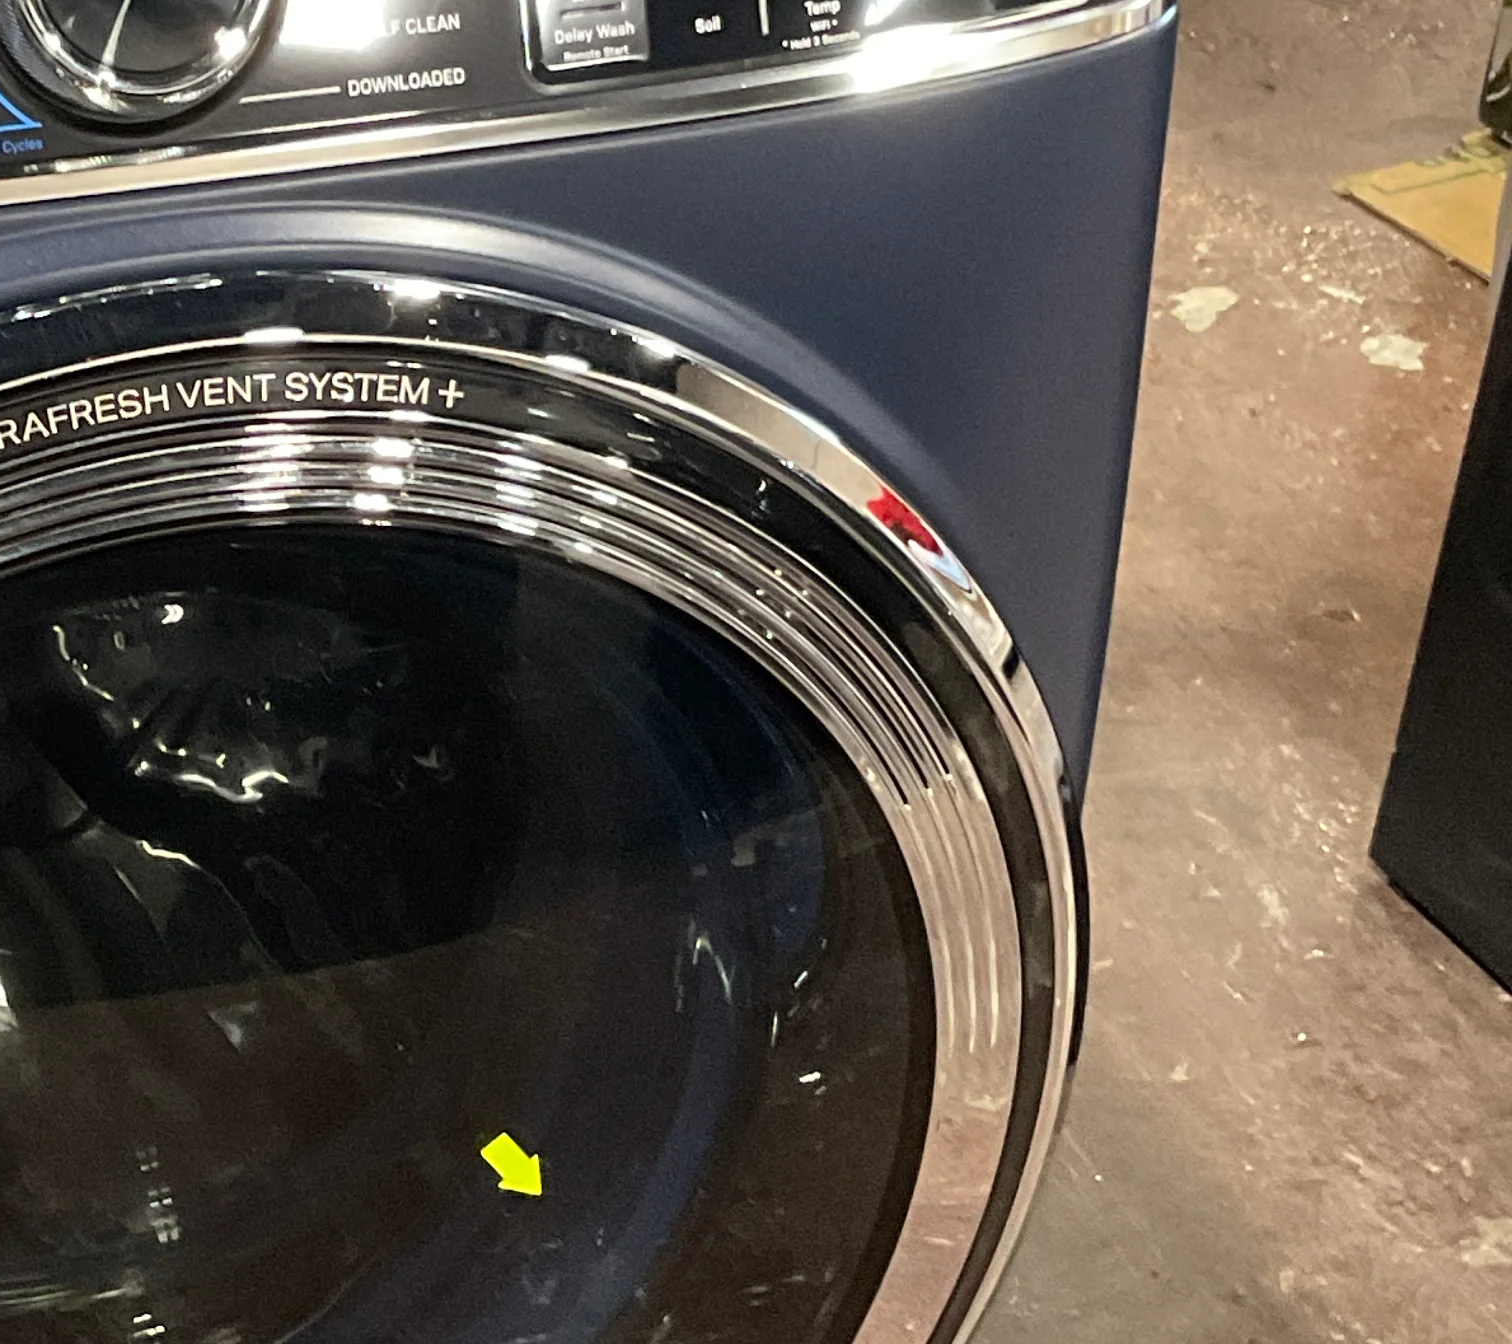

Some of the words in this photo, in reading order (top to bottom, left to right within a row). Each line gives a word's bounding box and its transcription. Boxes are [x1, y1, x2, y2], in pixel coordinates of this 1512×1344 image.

[803, 0, 841, 17] Temp
[405, 12, 461, 35] CLEAN
[554, 27, 593, 45] Delay
[596, 20, 636, 39] Wash
[694, 14, 722, 34] Soil
[347, 67, 466, 97] DOWNLOADED
[2, 138, 44, 155] Cycles
[176, 373, 276, 408] VENT
[284, 371, 431, 406] SYSTEM
